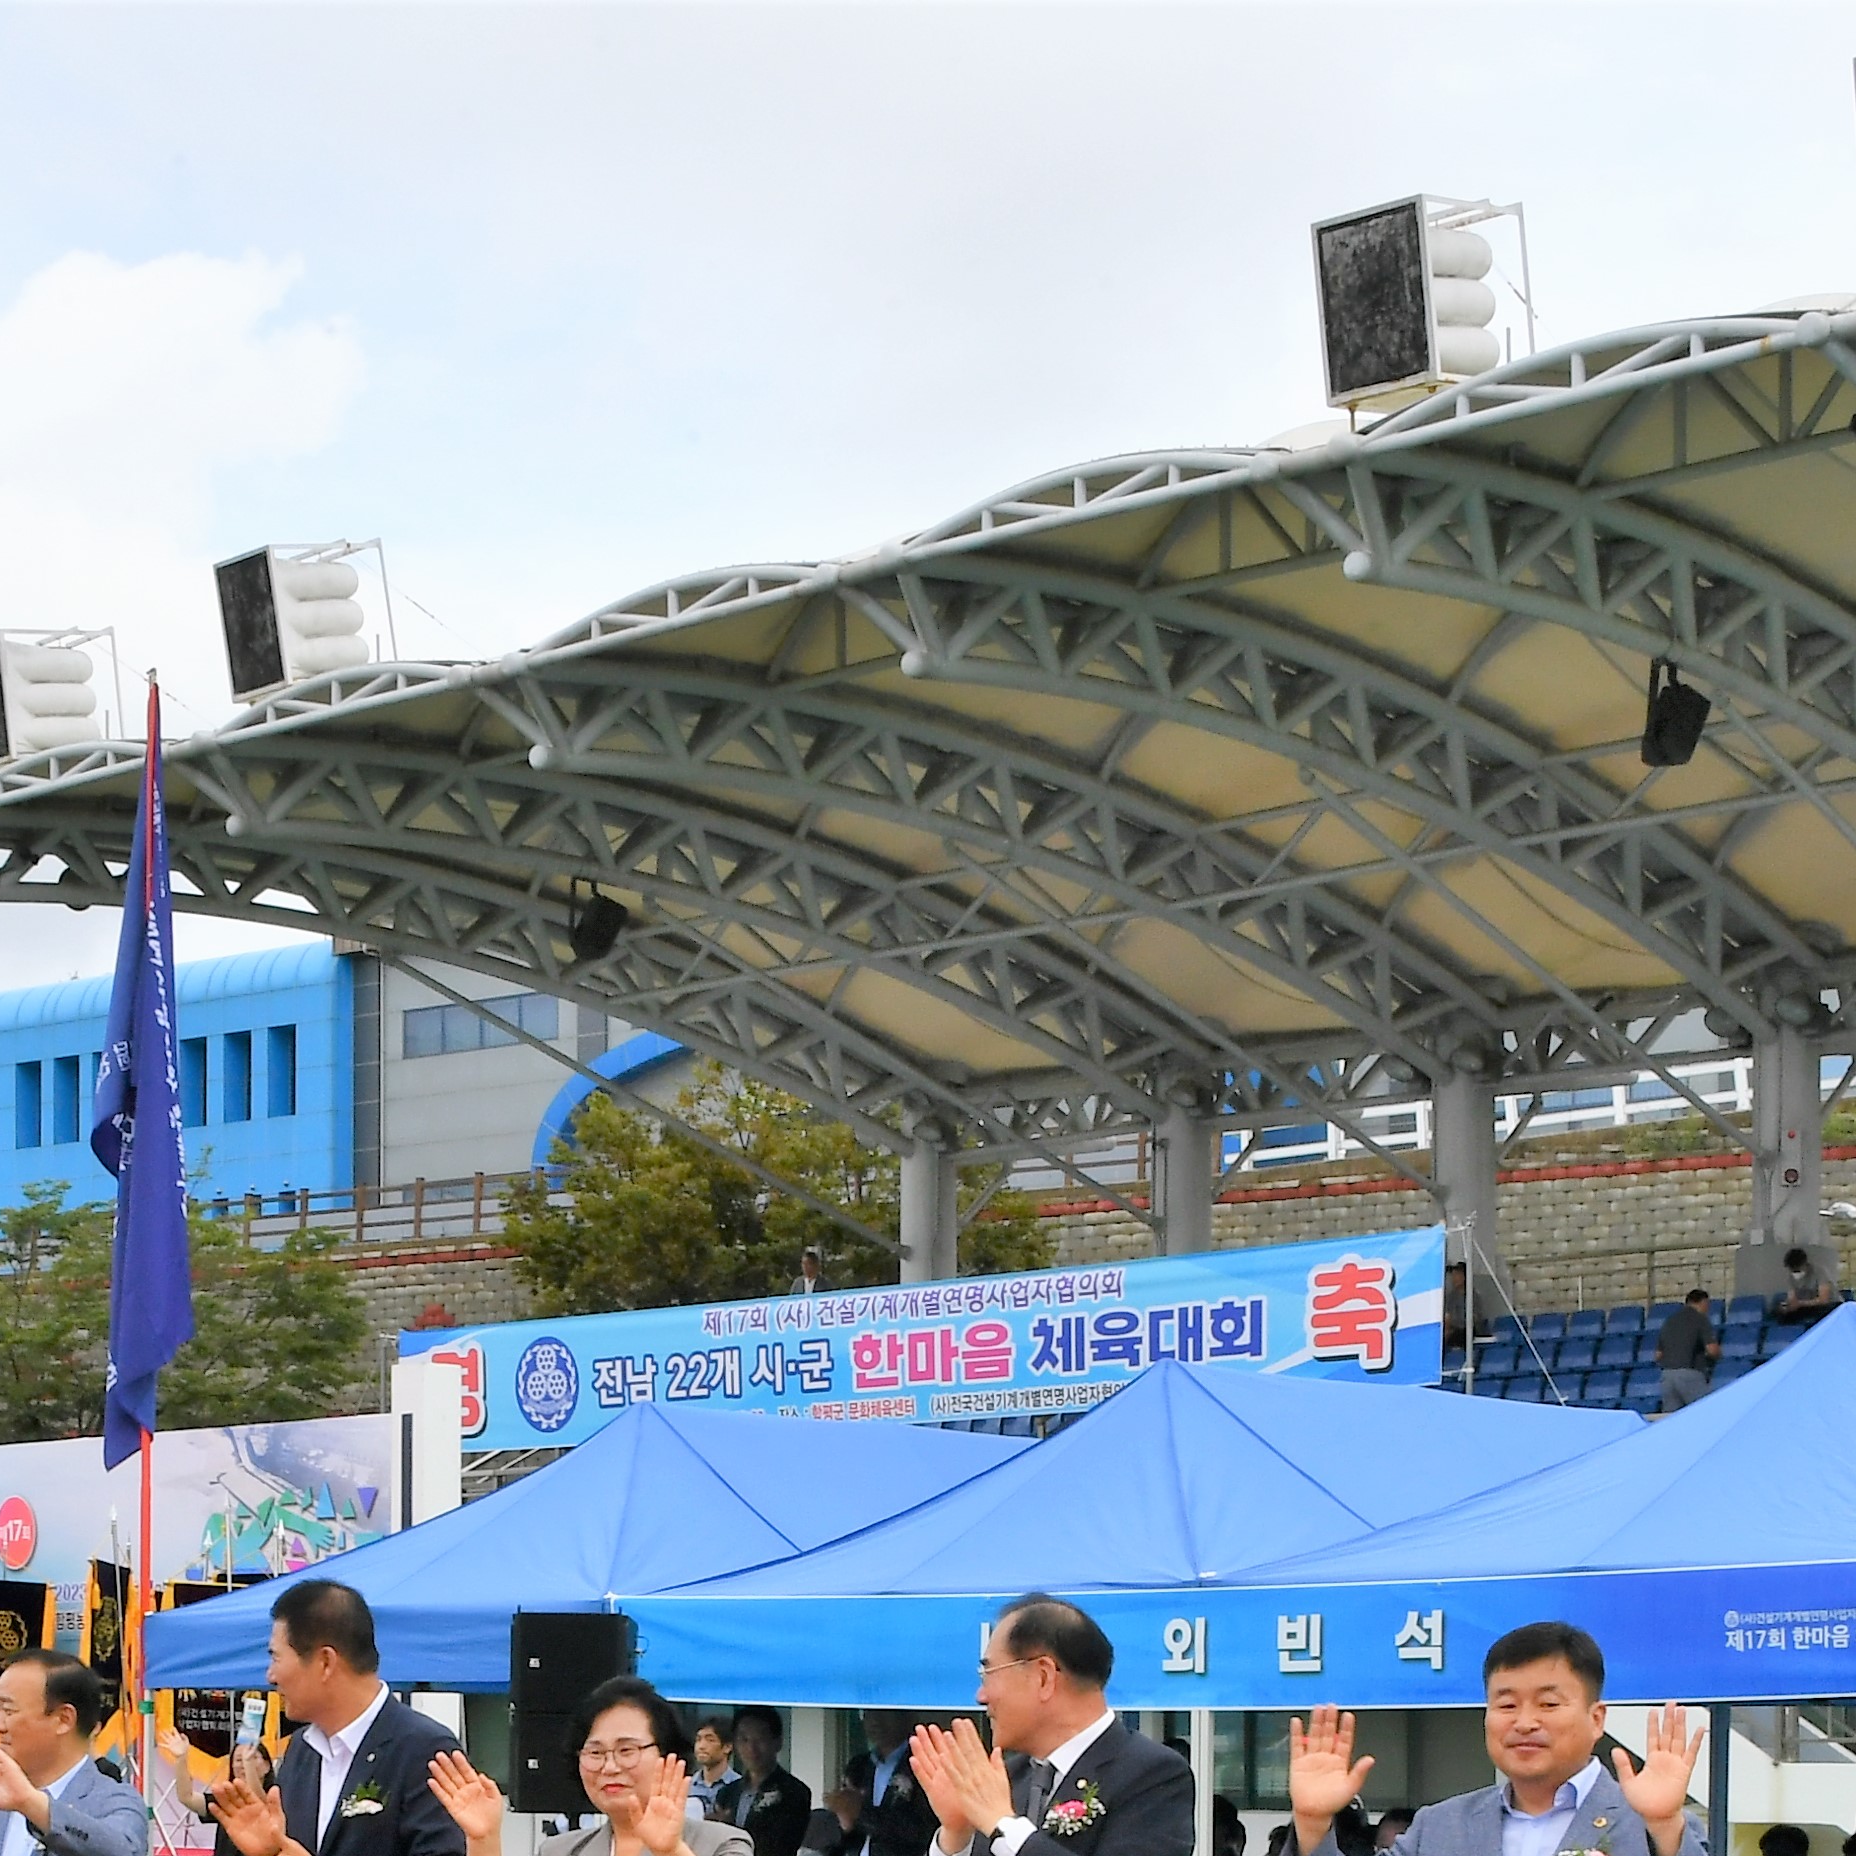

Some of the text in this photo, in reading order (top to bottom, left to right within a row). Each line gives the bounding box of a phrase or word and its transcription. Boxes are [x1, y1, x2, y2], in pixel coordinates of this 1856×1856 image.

[702, 1269, 1124, 1338] 제17회 (사) 건설기계개별연명사업자협의회
[1311, 1262, 1388, 1360] 축
[592, 1298, 1264, 1408] 전남 22개 시·군 한마음 체육대회
[848, 1397, 917, 1420] 문화체육센터
[1725, 1627, 1786, 1652] 제17회
[1792, 1623, 1850, 1649] 한마음
